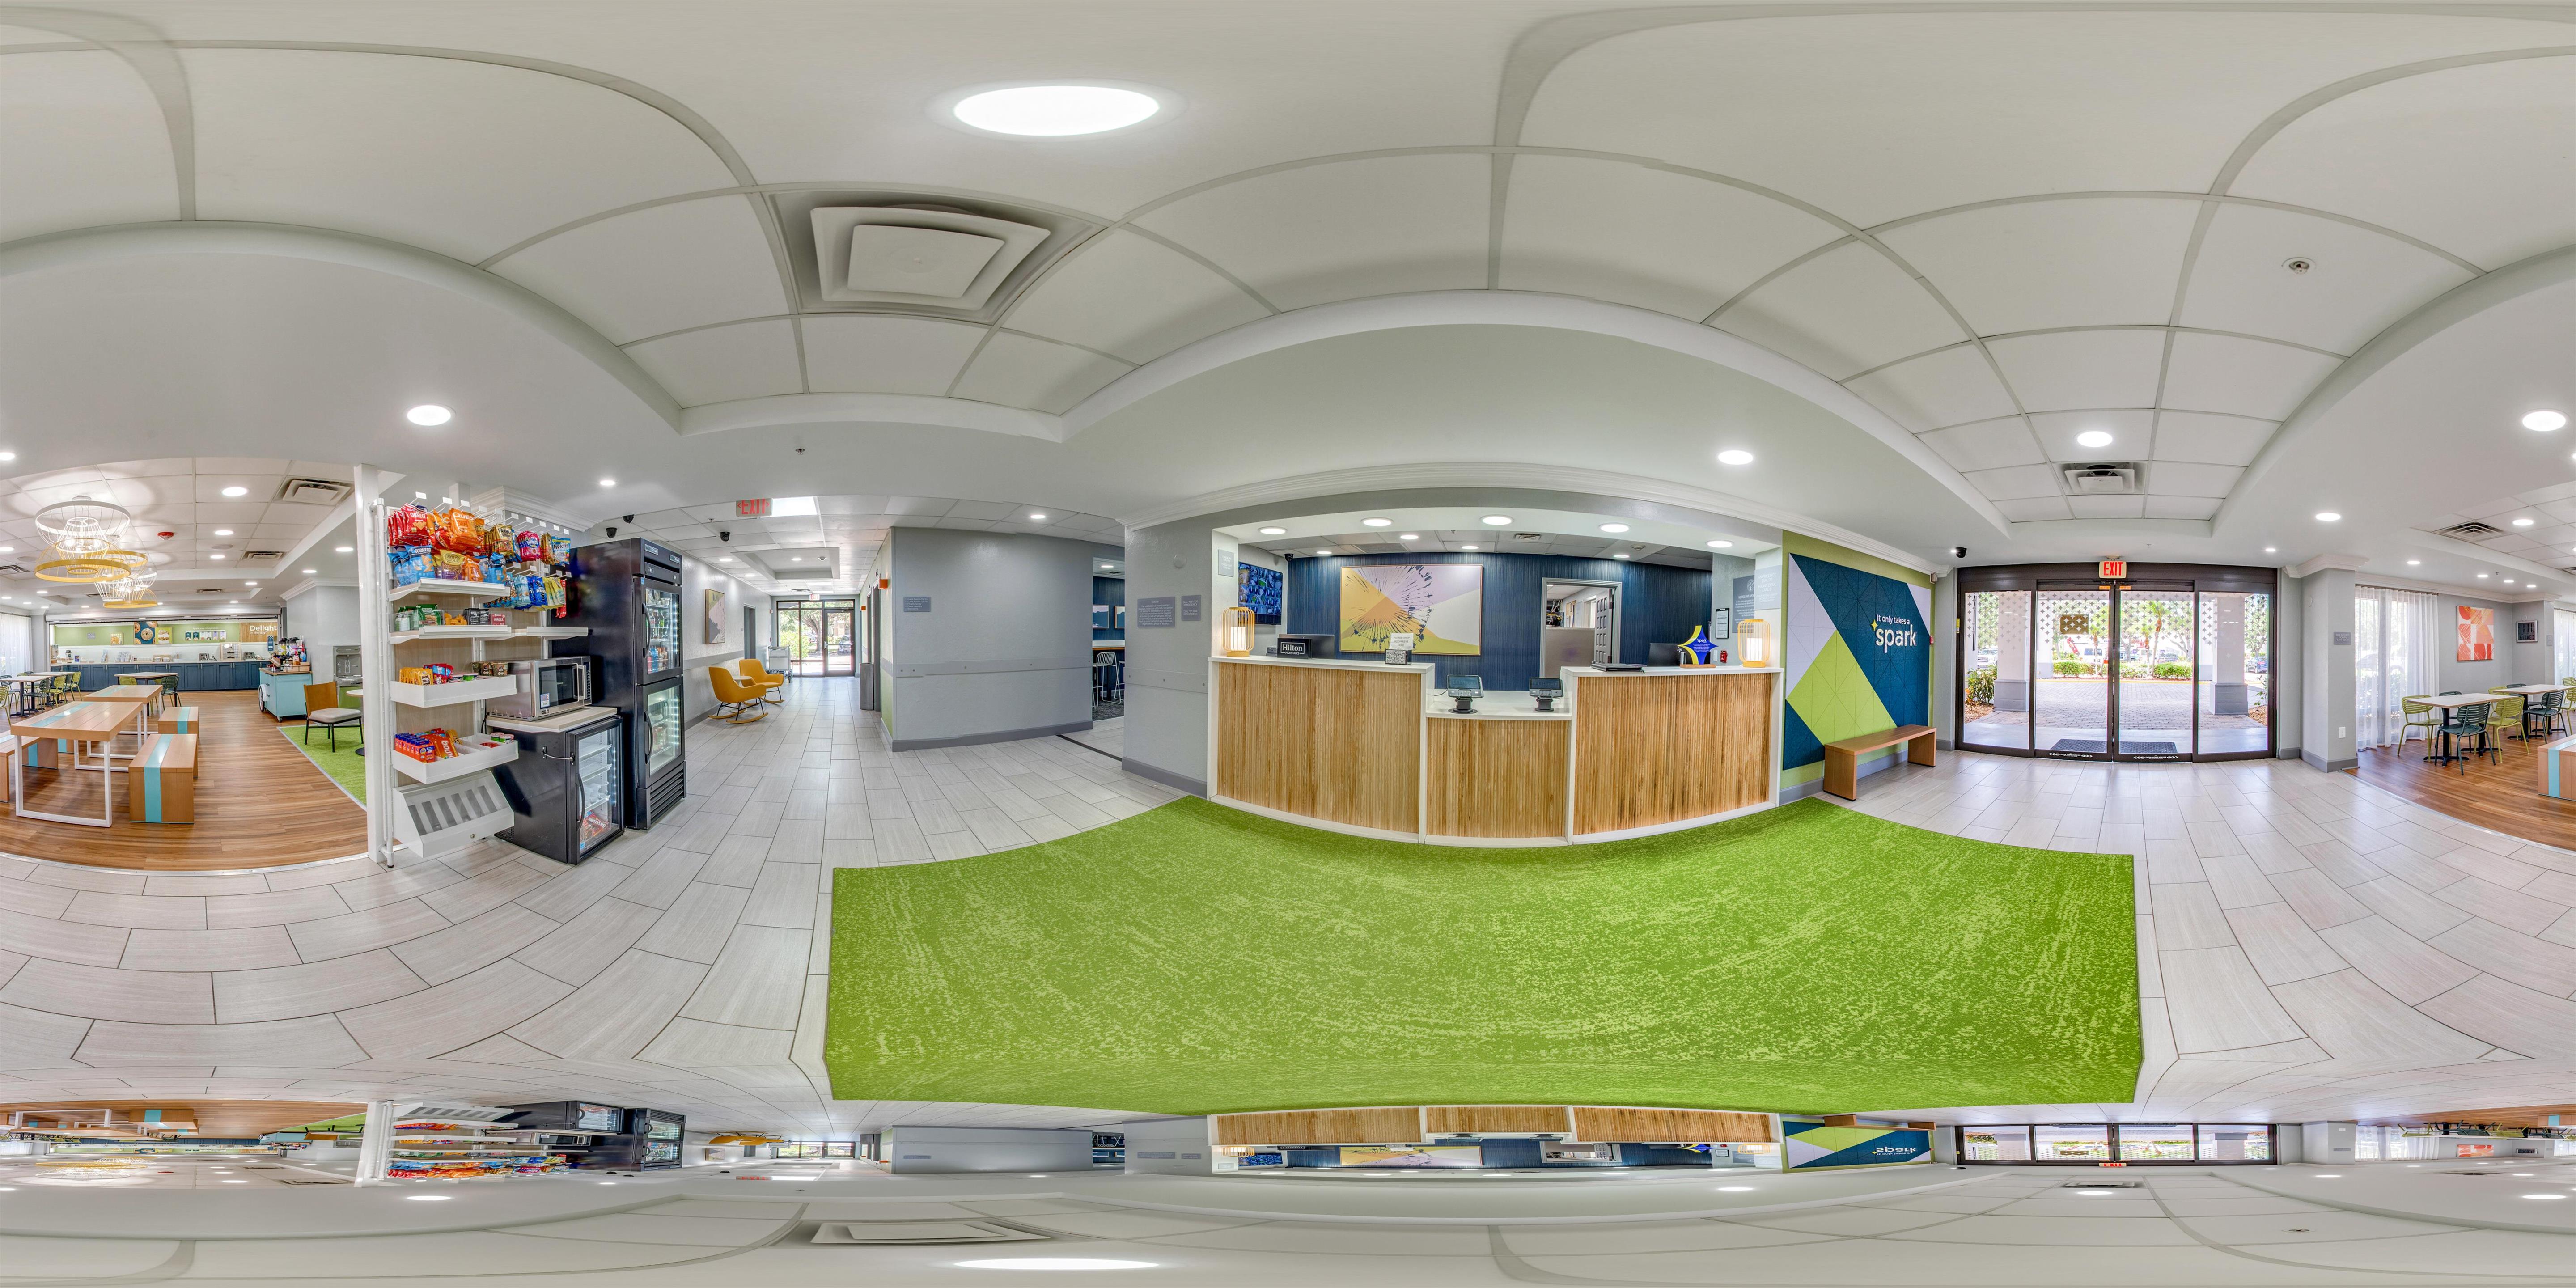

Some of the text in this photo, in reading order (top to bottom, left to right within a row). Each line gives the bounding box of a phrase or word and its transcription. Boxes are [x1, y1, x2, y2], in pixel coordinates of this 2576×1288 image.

[741, 498, 766, 515] EXIT
[2104, 562, 2123, 576] EXIT
[1882, 615, 1893, 624] only
[1876, 624, 1916, 654] spark
